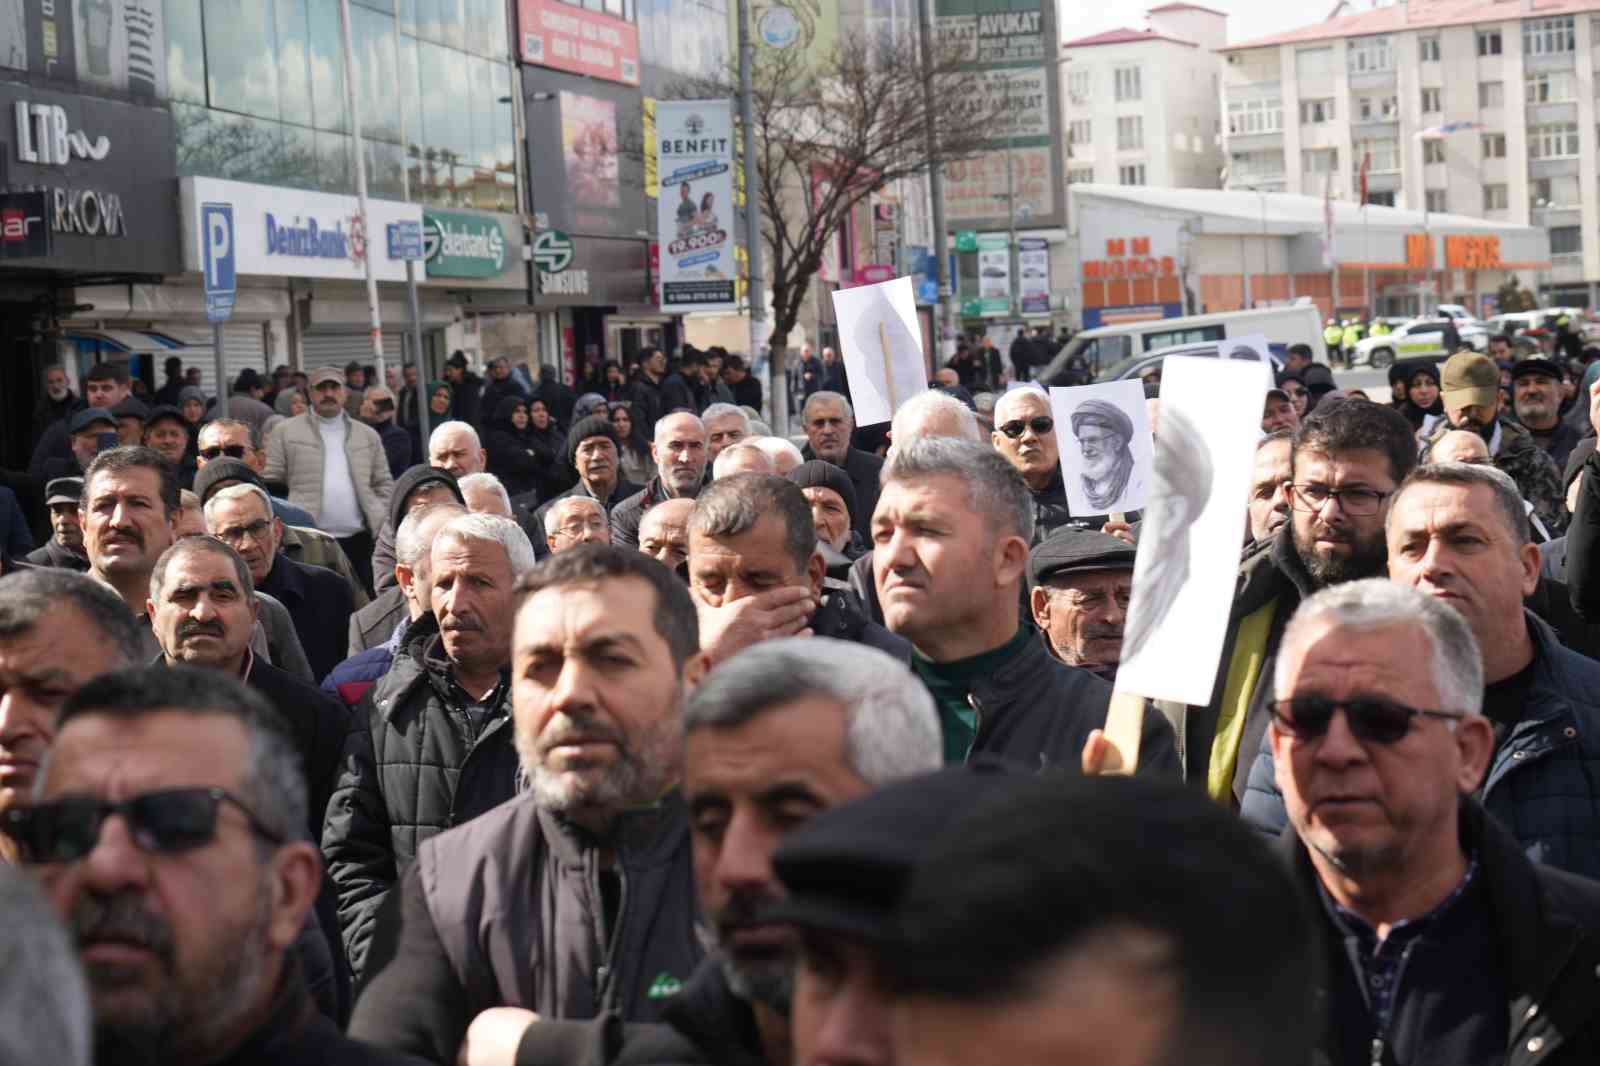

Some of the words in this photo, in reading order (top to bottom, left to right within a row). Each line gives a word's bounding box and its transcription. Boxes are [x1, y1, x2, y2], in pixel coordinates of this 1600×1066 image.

[980, 11, 1040, 33] AVUKAT
[15, 101, 69, 165] LTB
[662, 139, 727, 154] BENFIT
[265, 212, 347, 258] DenizBank
[208, 212, 230, 287] P
[1083, 256, 1174, 279] MIGROS
[541, 270, 588, 295] SAMSUNG
